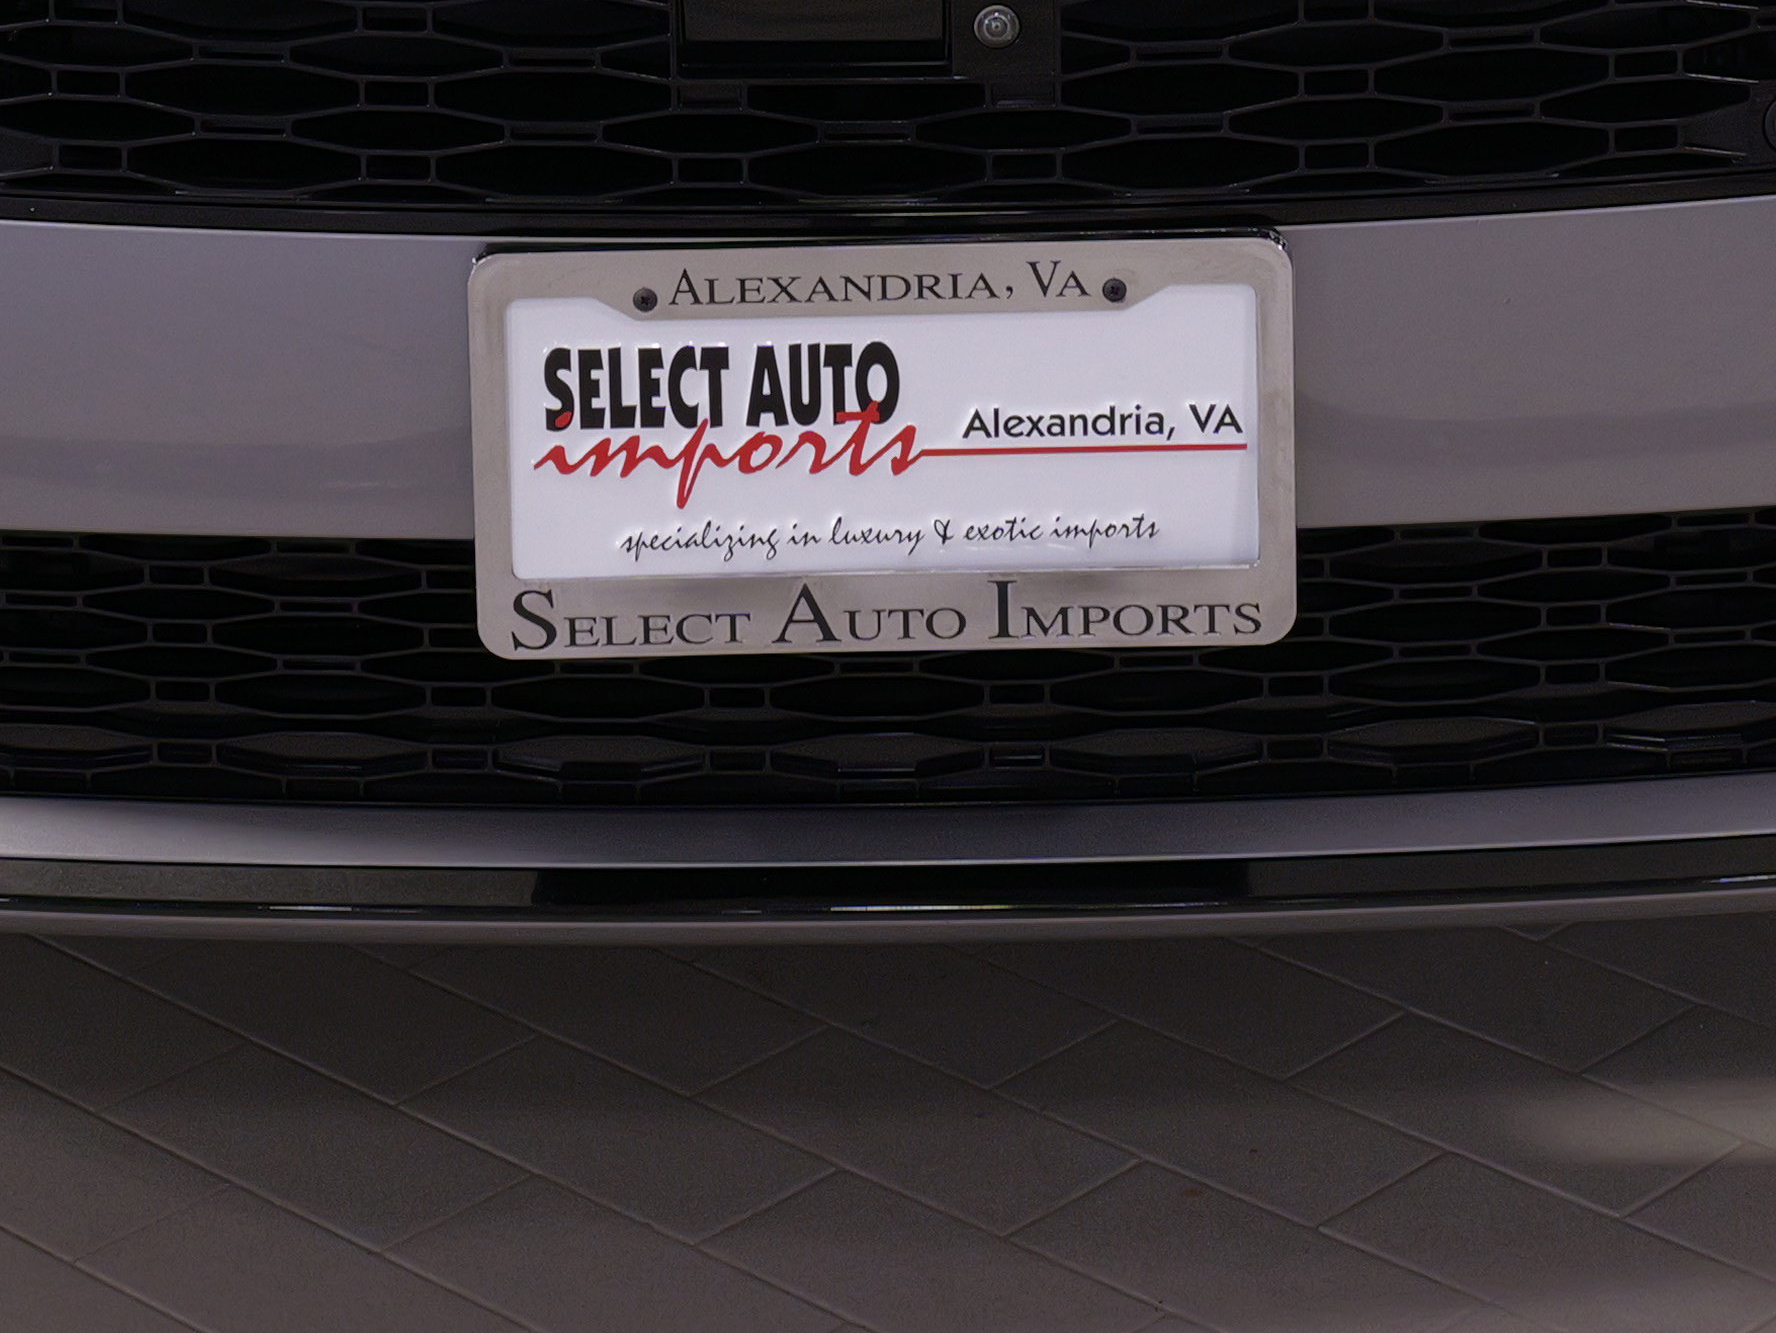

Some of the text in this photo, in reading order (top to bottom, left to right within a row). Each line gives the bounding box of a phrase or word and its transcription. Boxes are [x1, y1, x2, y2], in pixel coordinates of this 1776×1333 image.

[543, 340, 901, 432] SELECT AUTO
[533, 400, 924, 510] imports
[961, 403, 1243, 441] Alexandria, VA
[620, 513, 1160, 562] specializing in luxury & exotic imports
